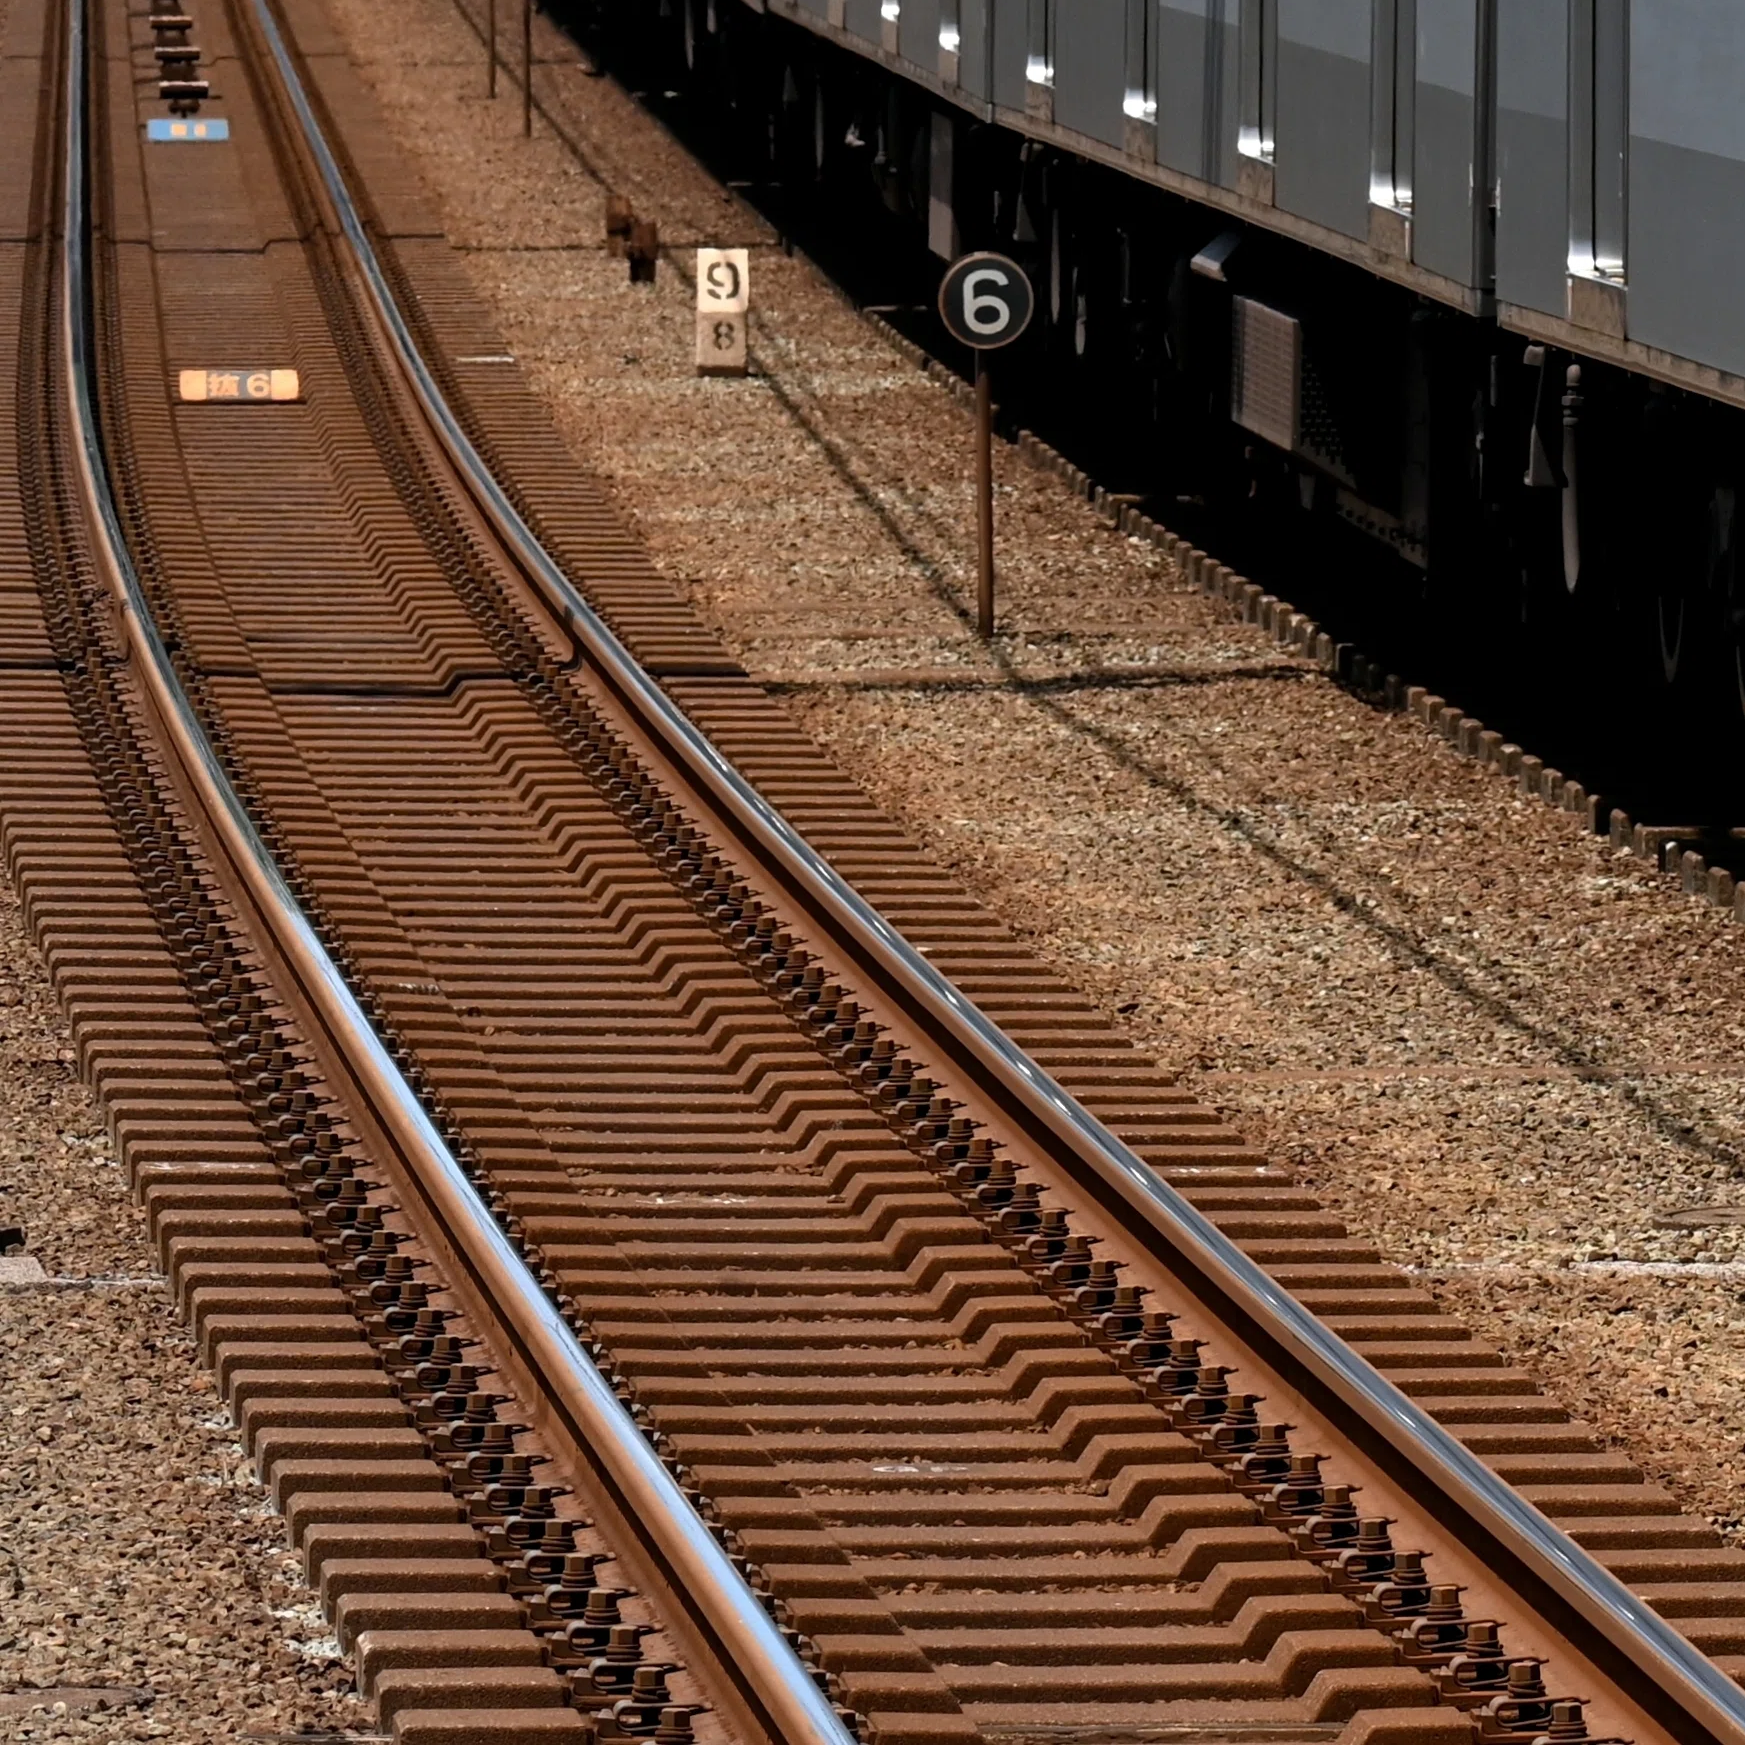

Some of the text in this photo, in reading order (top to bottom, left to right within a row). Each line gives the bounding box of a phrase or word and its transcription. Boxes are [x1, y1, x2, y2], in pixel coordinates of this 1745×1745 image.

[706, 260, 741, 301] 9
[962, 268, 1011, 335] 6
[712, 320, 736, 351] 8
